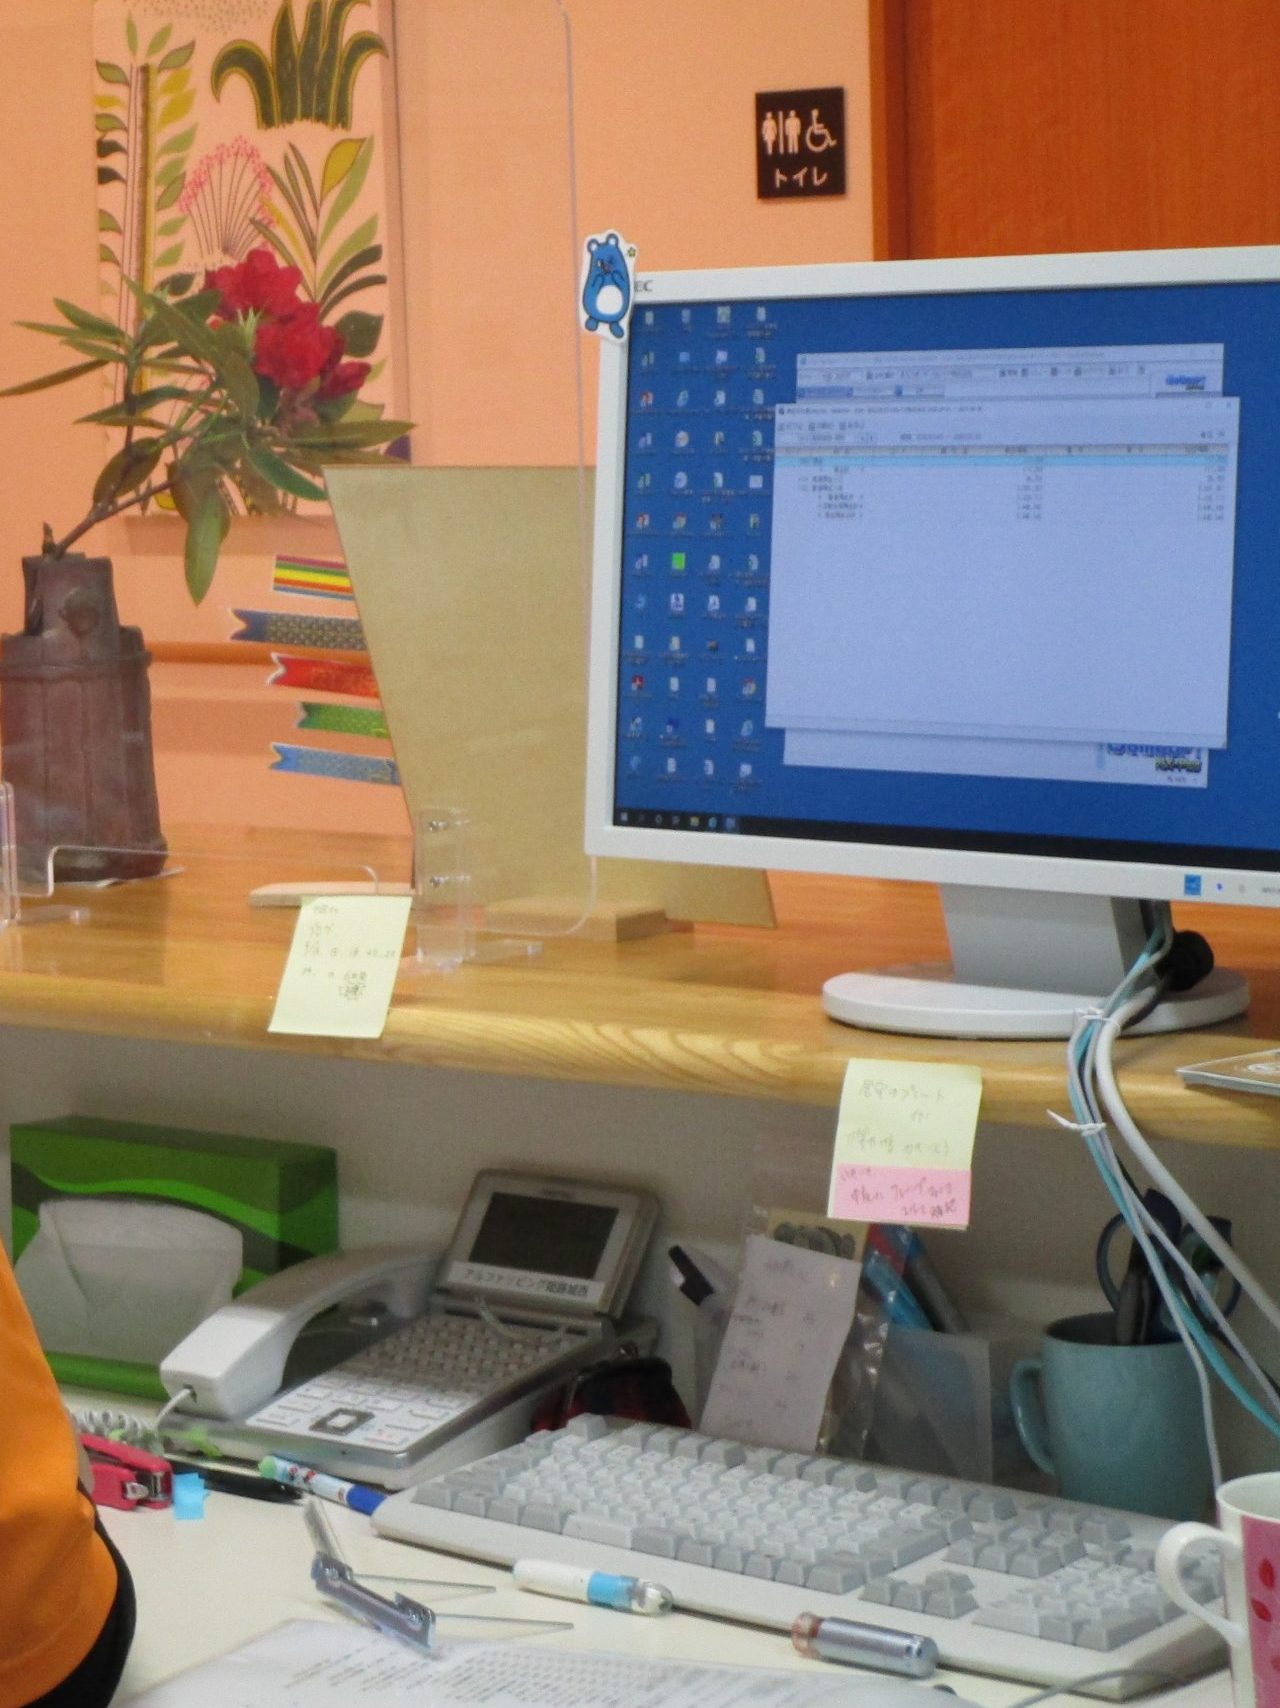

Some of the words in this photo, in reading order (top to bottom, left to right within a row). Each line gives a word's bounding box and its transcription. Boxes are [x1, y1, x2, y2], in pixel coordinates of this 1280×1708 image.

[774, 168, 828, 188] トイレ
[634, 279, 653, 293] EC
